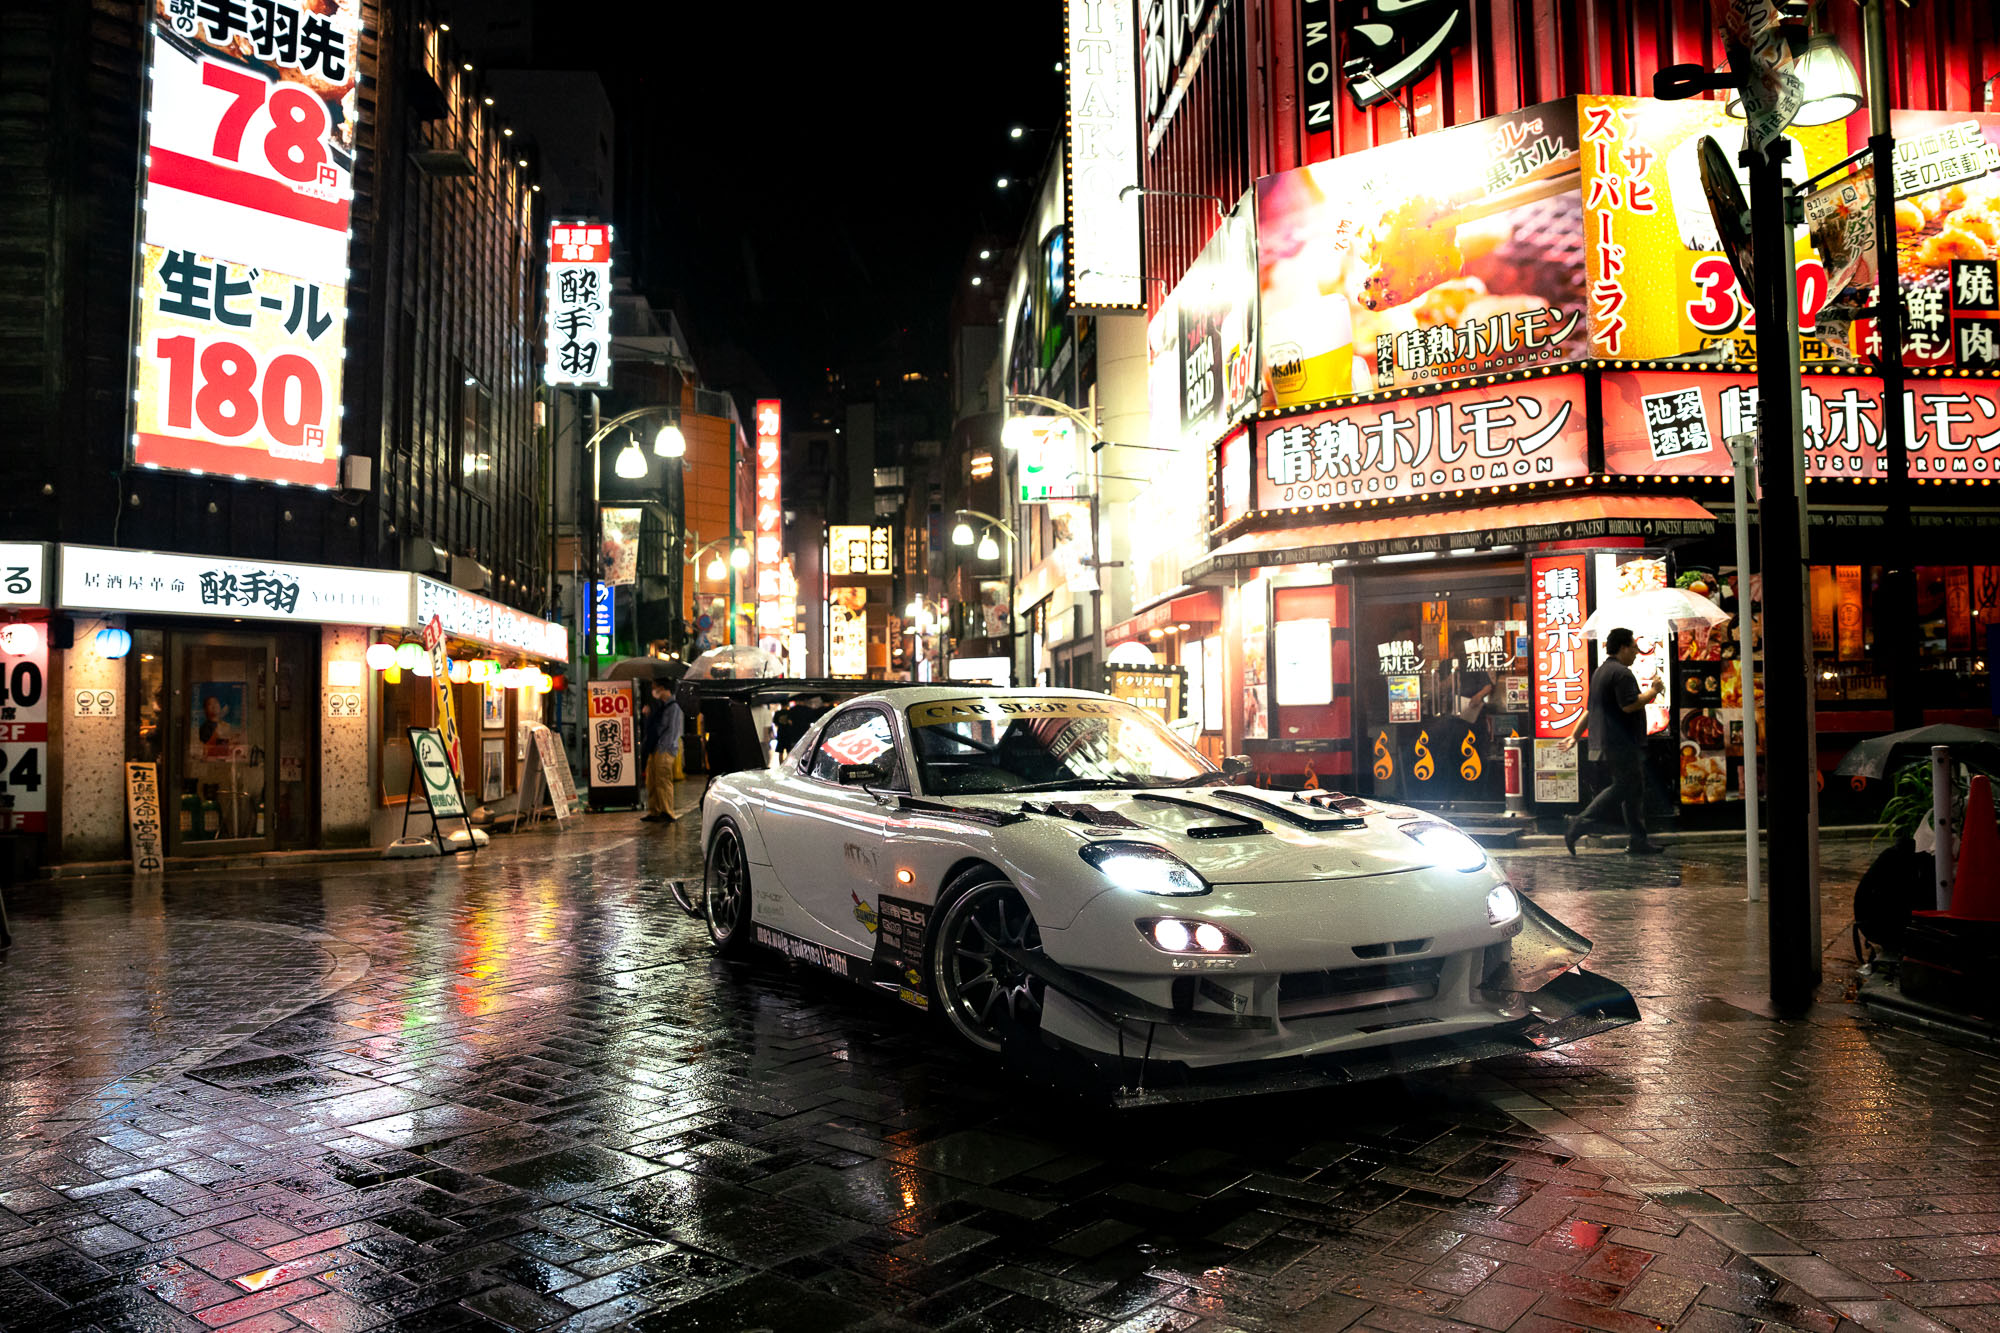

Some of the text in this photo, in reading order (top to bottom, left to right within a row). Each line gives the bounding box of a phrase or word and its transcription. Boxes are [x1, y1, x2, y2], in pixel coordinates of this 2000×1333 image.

[198, 0, 346, 82] 手羽先
[1305, 0, 1332, 126] MON
[1586, 106, 1625, 355] スーパードライ
[159, 249, 332, 341] 生ビール
[1690, 260, 1828, 328] 30
[1186, 334, 1214, 384] EXTRA
[1397, 307, 1580, 372] 情熱ホルモン
[1412, 349, 1562, 381] JONETSU HORUMON
[1187, 369, 1214, 421] COLD
[1648, 391, 1703, 427] 池袋
[1720, 386, 2000, 452] 情ホルモン
[1266, 396, 1572, 487] 情熱ホルモン
[1652, 421, 1708, 456] 酒場
[1284, 457, 1554, 502] JONETSU HORUMON
[4, 566, 32, 594] る
[1379, 655, 1426, 673] ホルモン
[1466, 652, 1516, 669] ホルモン
[1544, 566, 1585, 731] 情熱ホルモン
[926, 703, 991, 719] CAR
[1171, 958, 1240, 971] VOTEX
